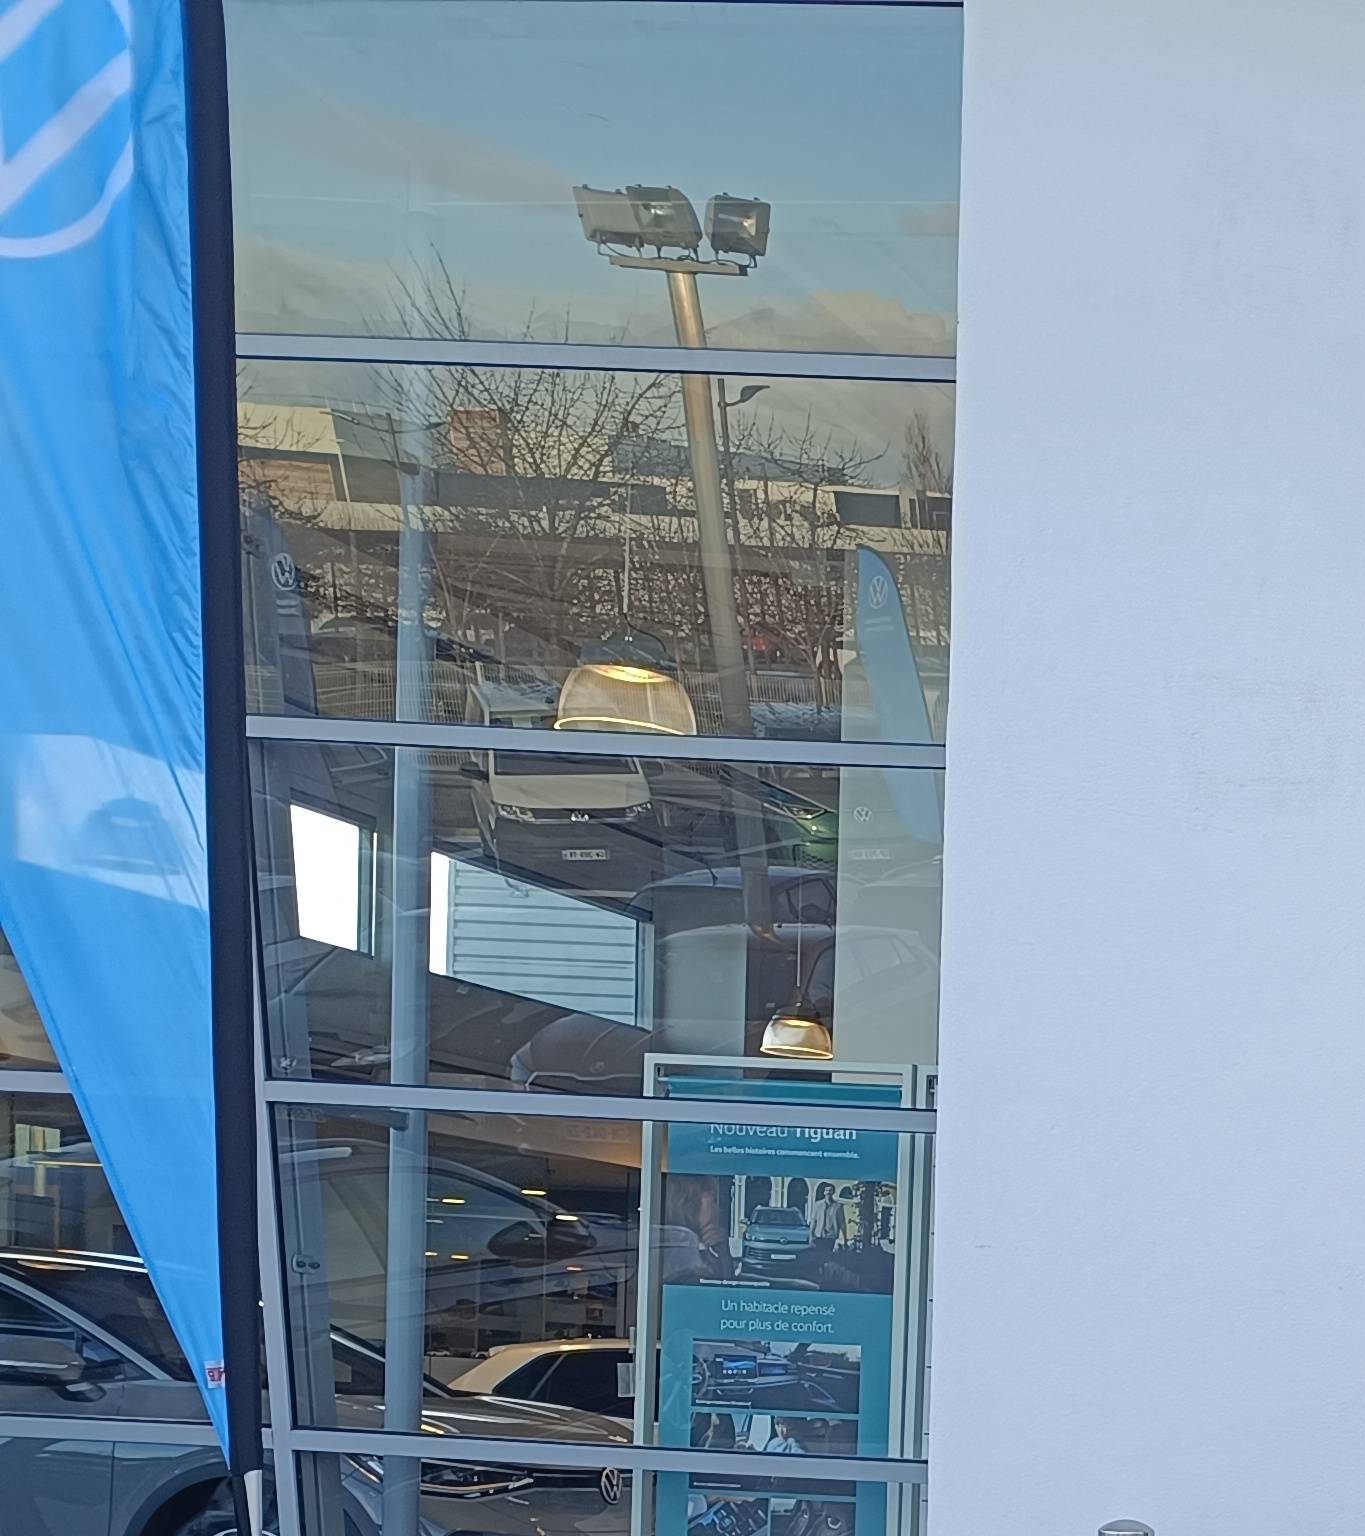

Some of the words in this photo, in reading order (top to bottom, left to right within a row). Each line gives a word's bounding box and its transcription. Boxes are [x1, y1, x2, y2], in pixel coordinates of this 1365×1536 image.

[721, 1300, 738, 1311] Un
[739, 1300, 788, 1314] habitacle
[790, 1304, 836, 1317] repensé
[720, 1319, 746, 1331] pour
[749, 1318, 771, 1331] plus
[774, 1319, 789, 1331] de
[791, 1321, 835, 1333] confort.
